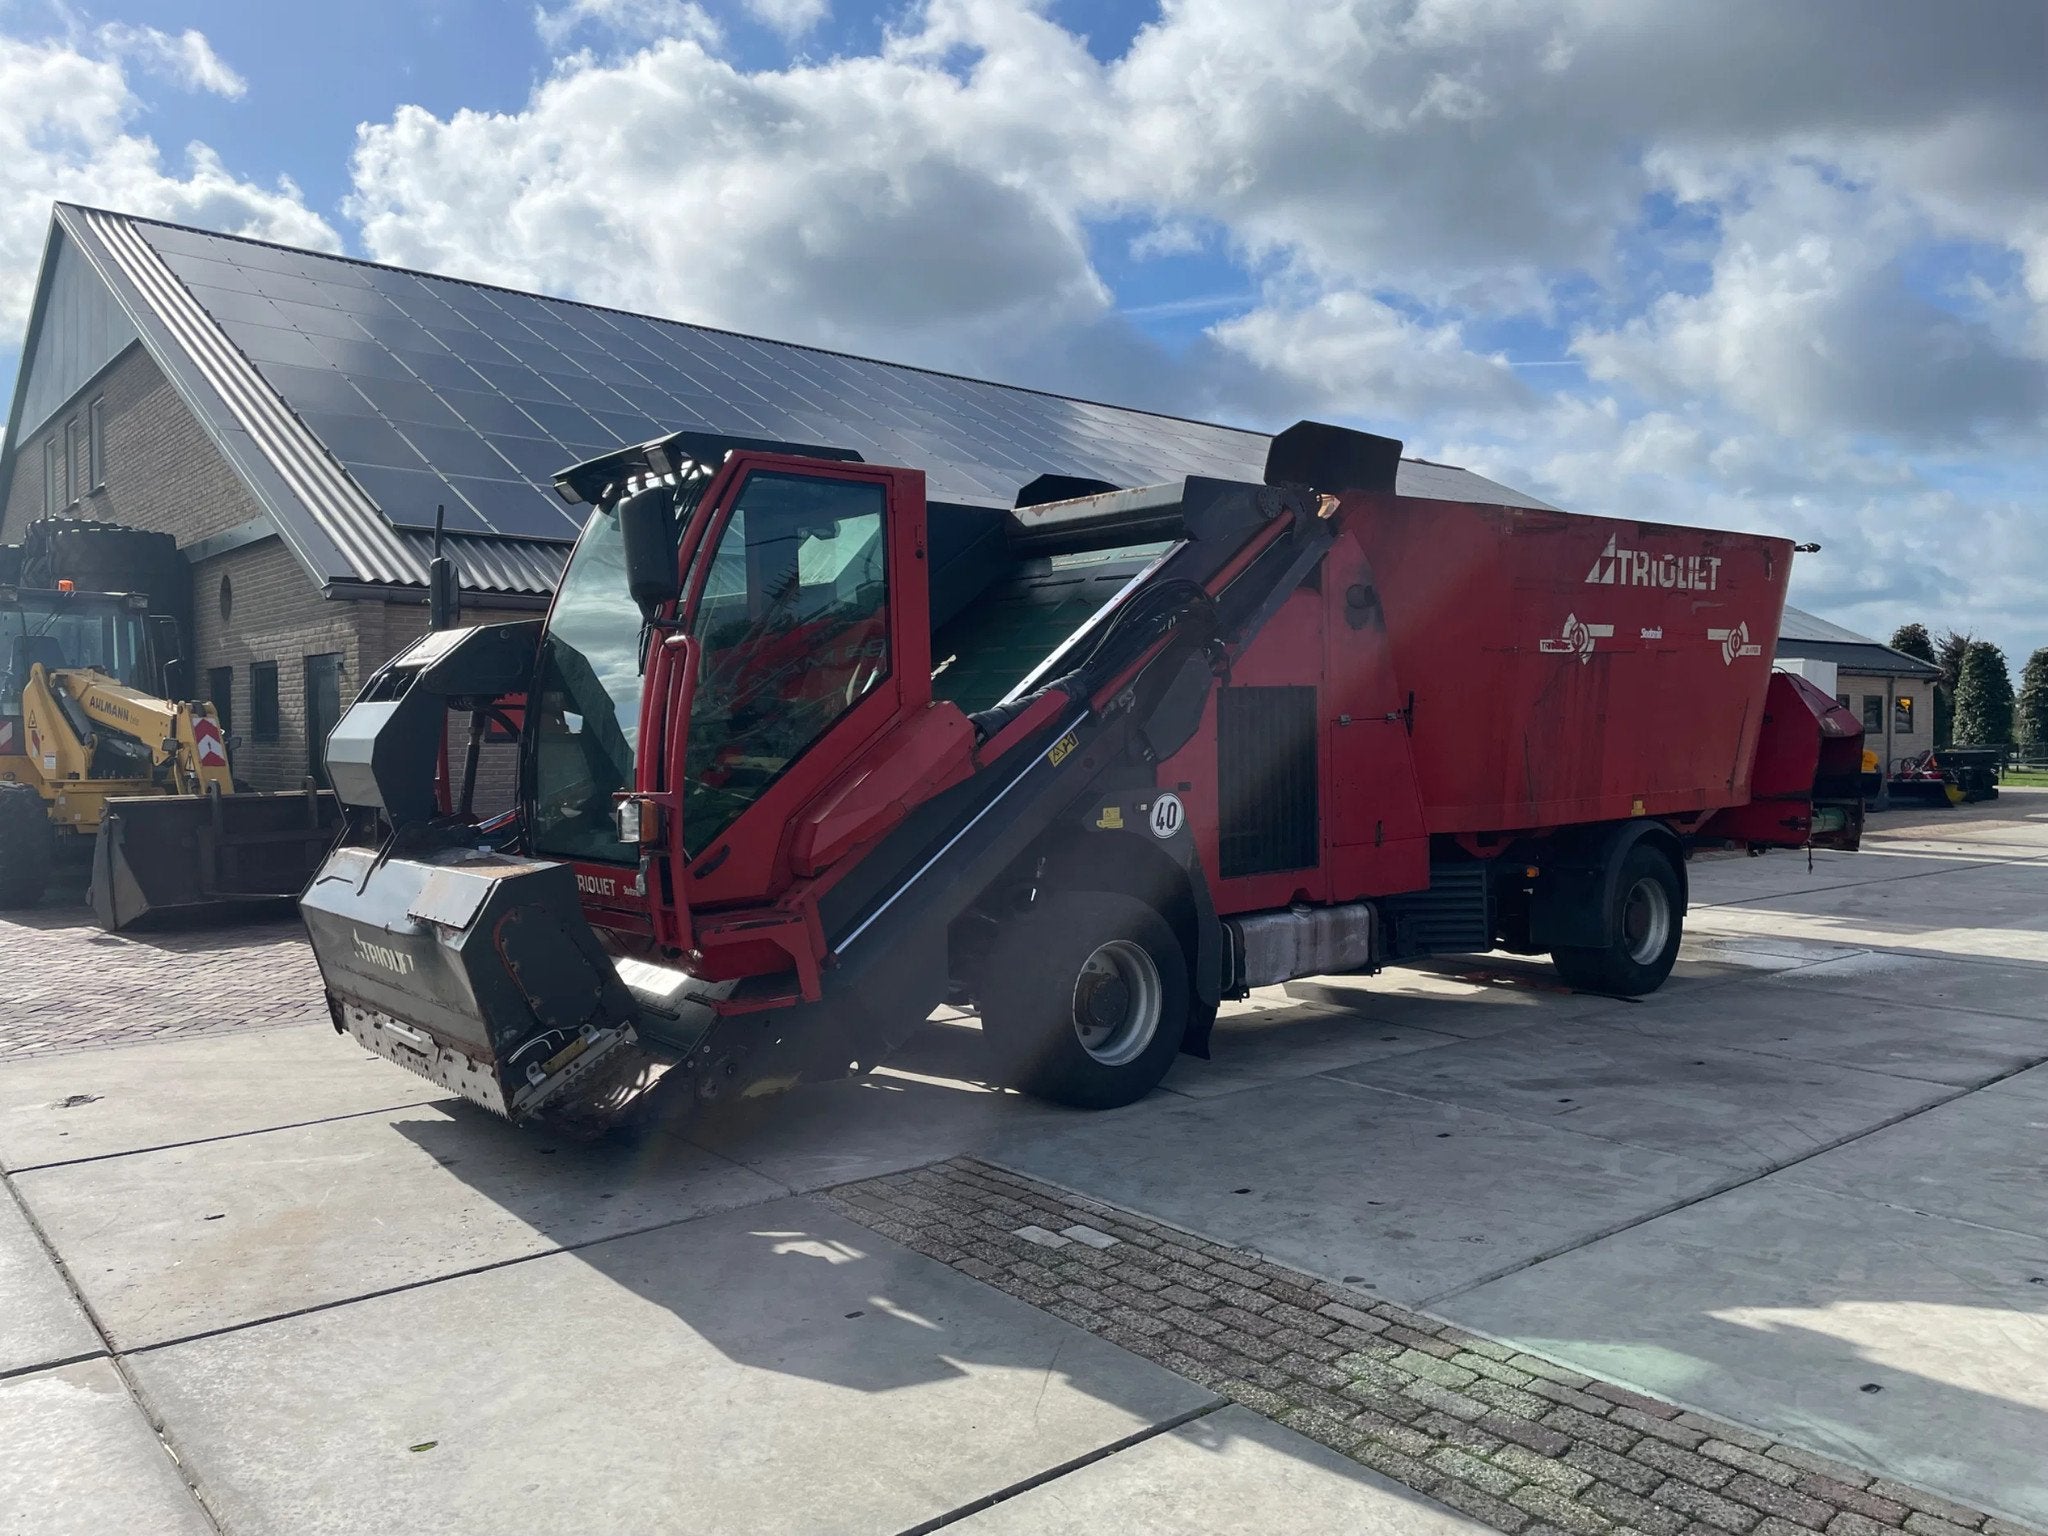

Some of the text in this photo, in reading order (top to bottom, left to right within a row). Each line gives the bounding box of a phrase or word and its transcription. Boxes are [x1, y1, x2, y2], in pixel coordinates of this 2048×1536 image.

[1616, 549, 1722, 591] TRIOLIET
[89, 695, 129, 722] AHLMANN
[1155, 801, 1178, 831] 40
